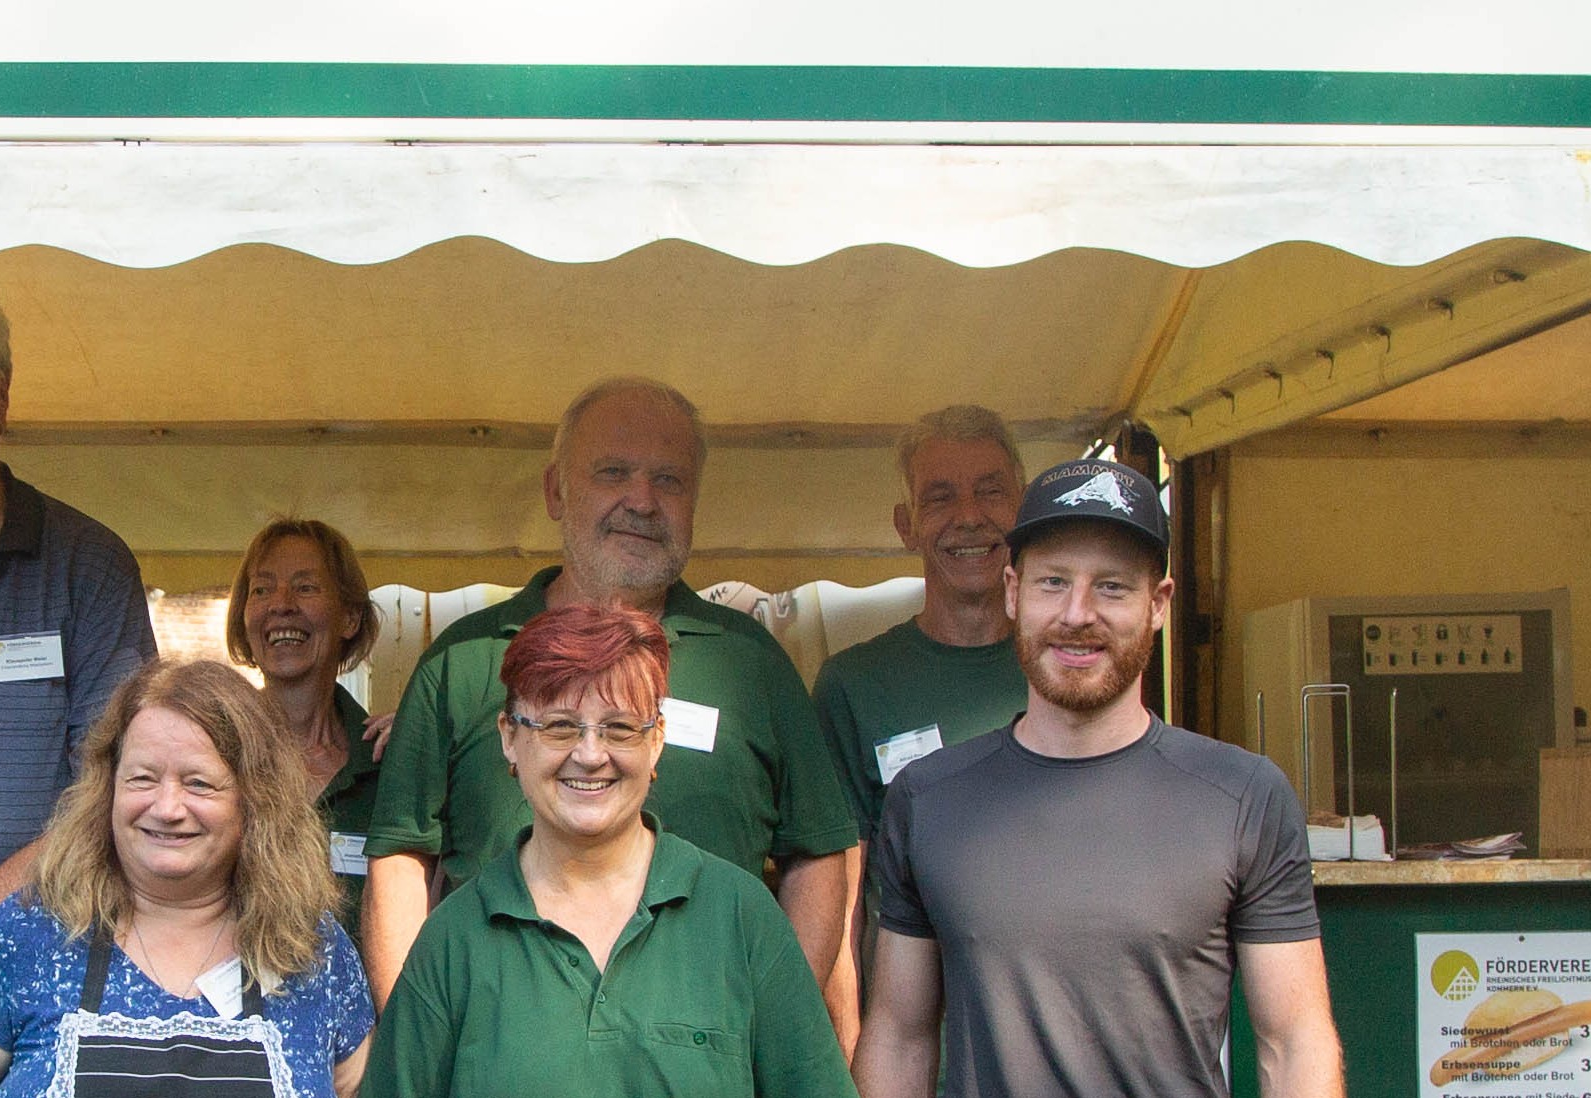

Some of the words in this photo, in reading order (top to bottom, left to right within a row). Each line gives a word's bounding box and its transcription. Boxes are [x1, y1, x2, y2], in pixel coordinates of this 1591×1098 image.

[1487, 975, 1536, 984] RHEINISCHES
[1441, 1026, 1510, 1036] Siedewurst
[1450, 1038, 1467, 1048] mit
[1523, 1037, 1547, 1047] oder
[1550, 1037, 1574, 1047] Brot
[1441, 1060, 1521, 1072] Erbsensuppe
[1451, 1072, 1468, 1082] mit
[1524, 1071, 1548, 1081] oder
[1551, 1071, 1574, 1081] Brot
